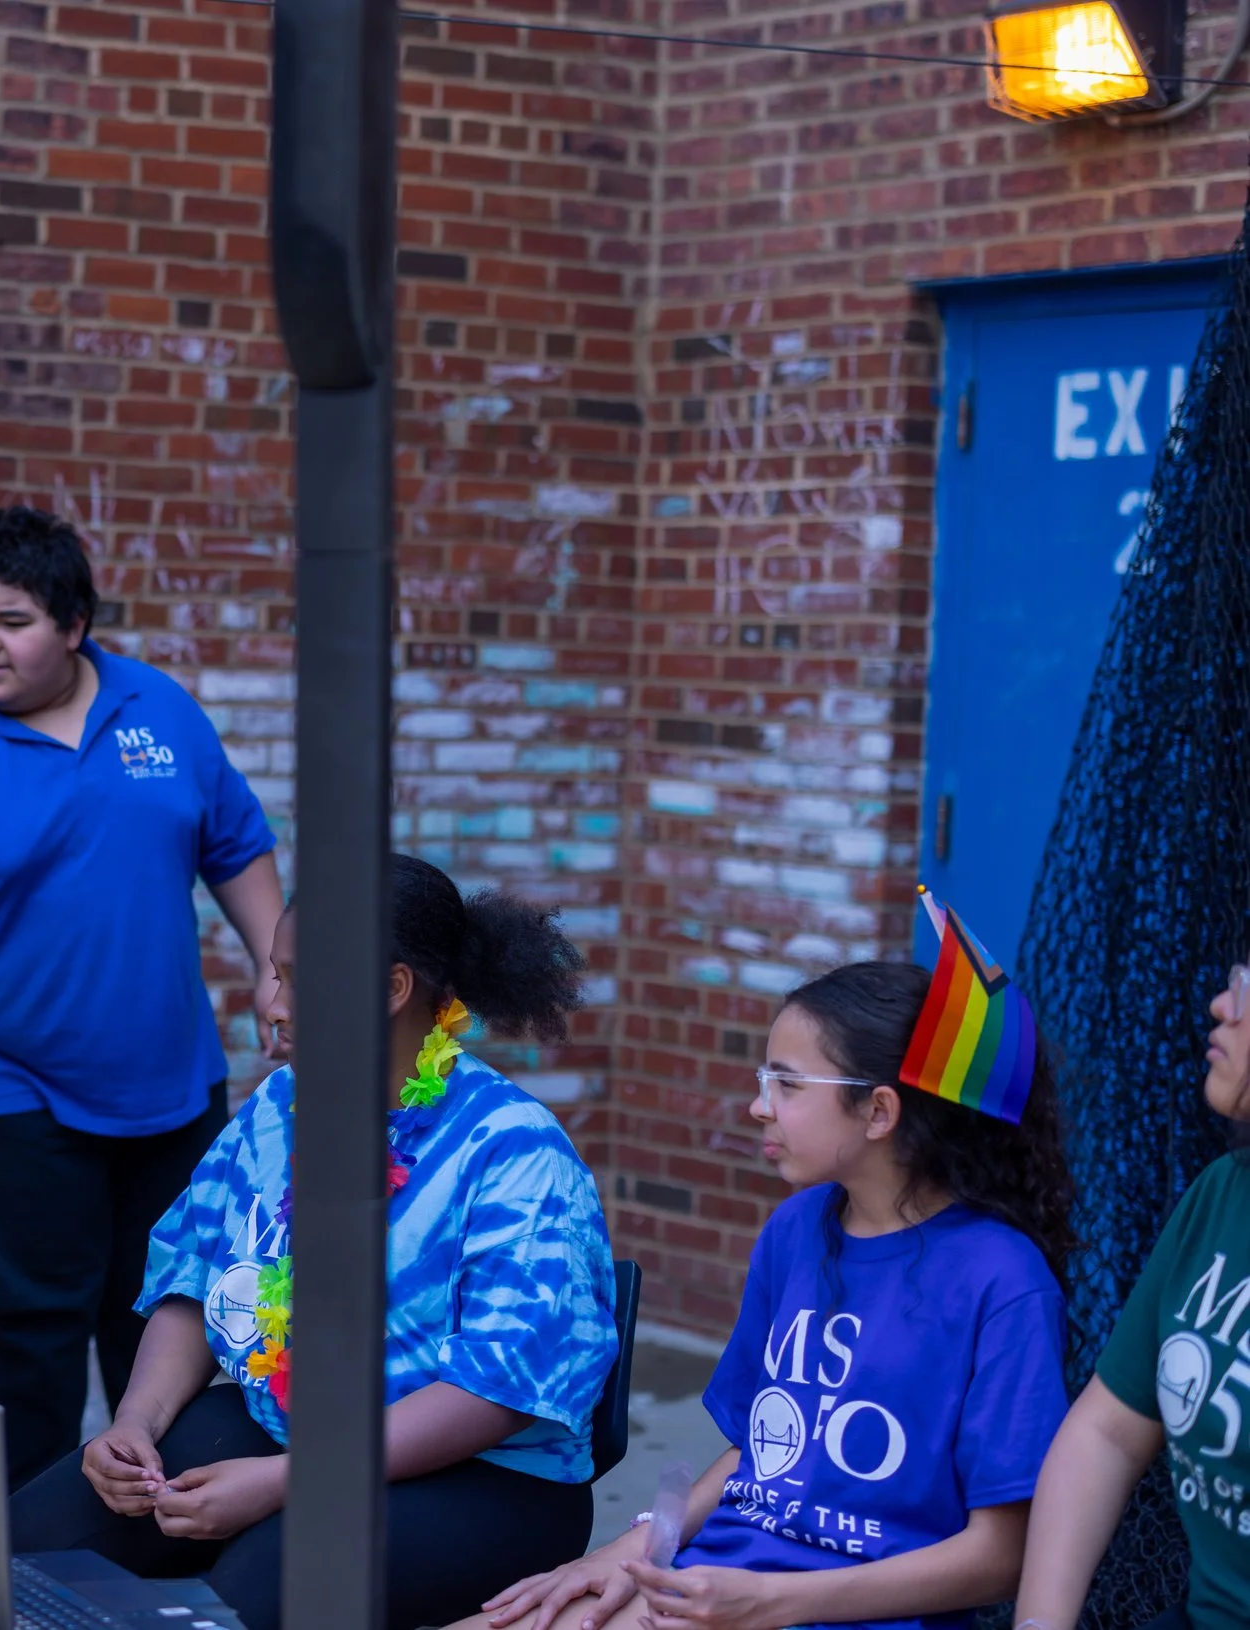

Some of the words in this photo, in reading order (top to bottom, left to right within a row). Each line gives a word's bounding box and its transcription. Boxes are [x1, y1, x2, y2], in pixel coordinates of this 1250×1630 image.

[1054, 365, 1188, 461] EXI
[115, 727, 154, 748] MS
[147, 746, 174, 765] 50
[763, 1309, 862, 1388] MS
[723, 1480, 779, 1512] PRIDE
[814, 1506, 882, 1538] THE
